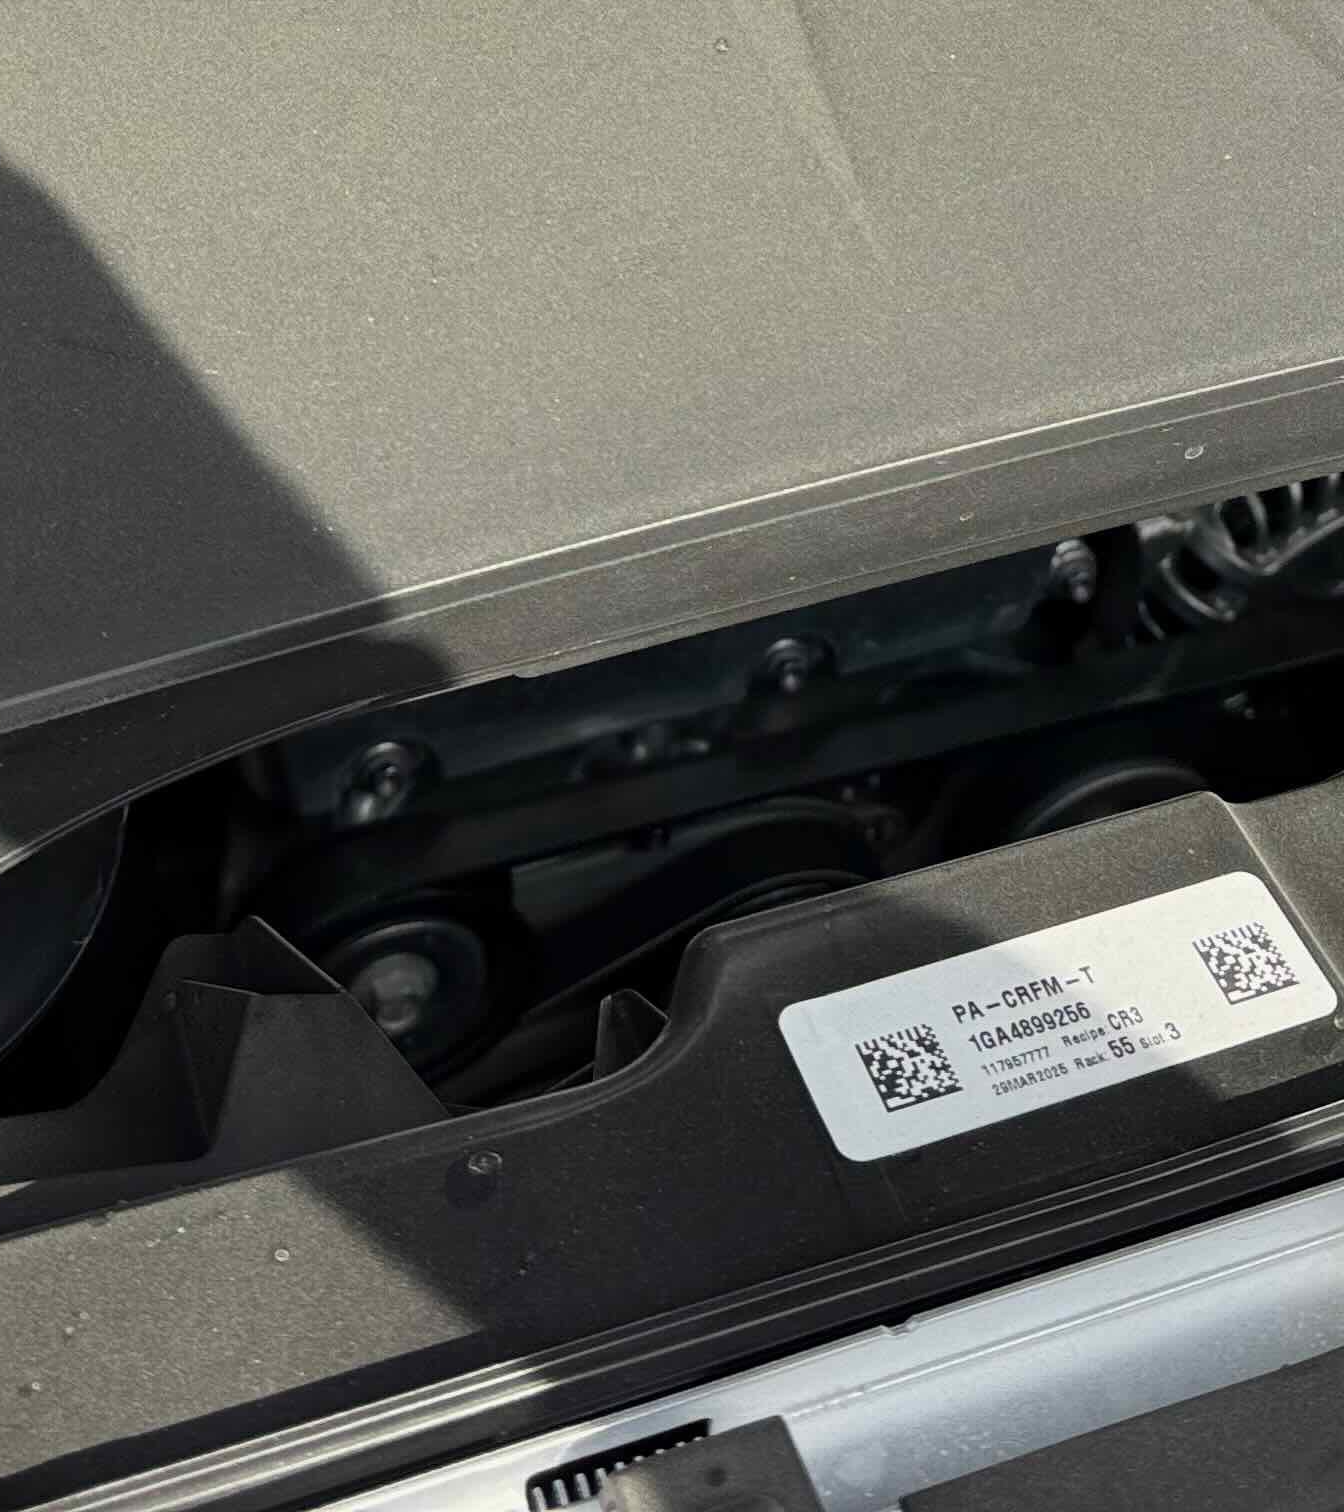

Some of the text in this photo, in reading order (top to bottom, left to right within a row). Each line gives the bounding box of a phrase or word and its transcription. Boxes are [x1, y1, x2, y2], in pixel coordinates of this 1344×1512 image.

[1107, 1007, 1144, 1031] CR3
[1108, 1036, 1137, 1059] 55
[1164, 1022, 1182, 1040] 3
